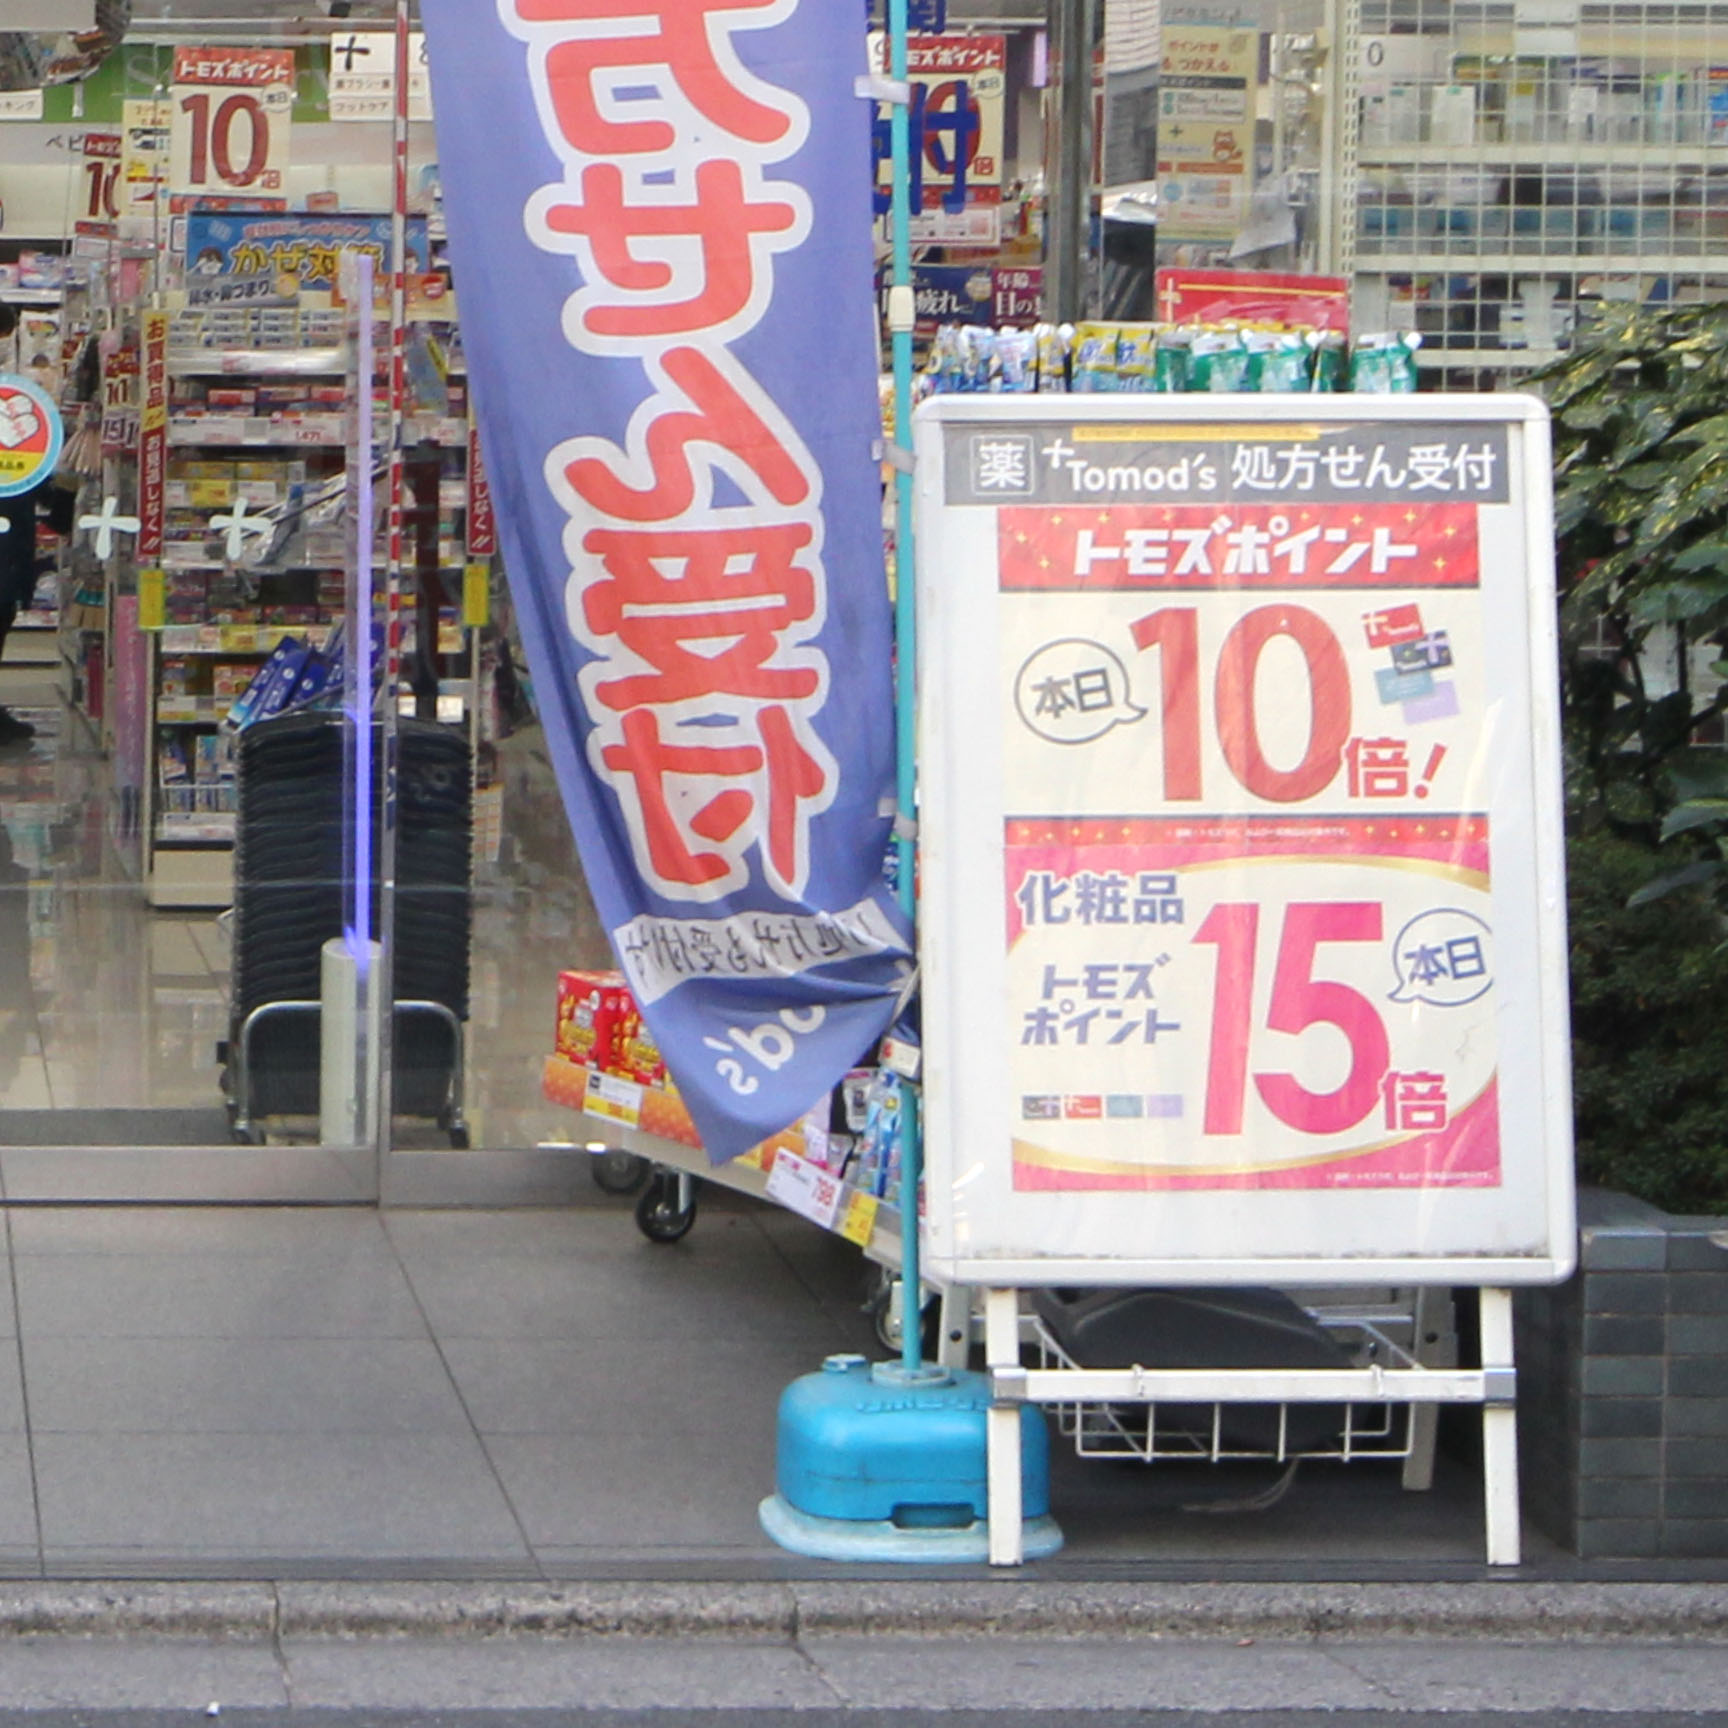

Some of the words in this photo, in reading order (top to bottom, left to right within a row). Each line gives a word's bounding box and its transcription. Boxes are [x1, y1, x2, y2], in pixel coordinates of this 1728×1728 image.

[179, 57, 290, 79] トモズポイント
[979, 443, 1026, 489] 薬
[1231, 443, 1497, 493] 処方せん受付
[1073, 514, 1420, 576] トモズポイント
[1030, 667, 1117, 721] 本日
[1018, 873, 1186, 926] 化粧品
[1040, 953, 1172, 1002] トモズ
[1404, 935, 1489, 987] 本日
[1020, 1000, 1183, 1047] ポイント
